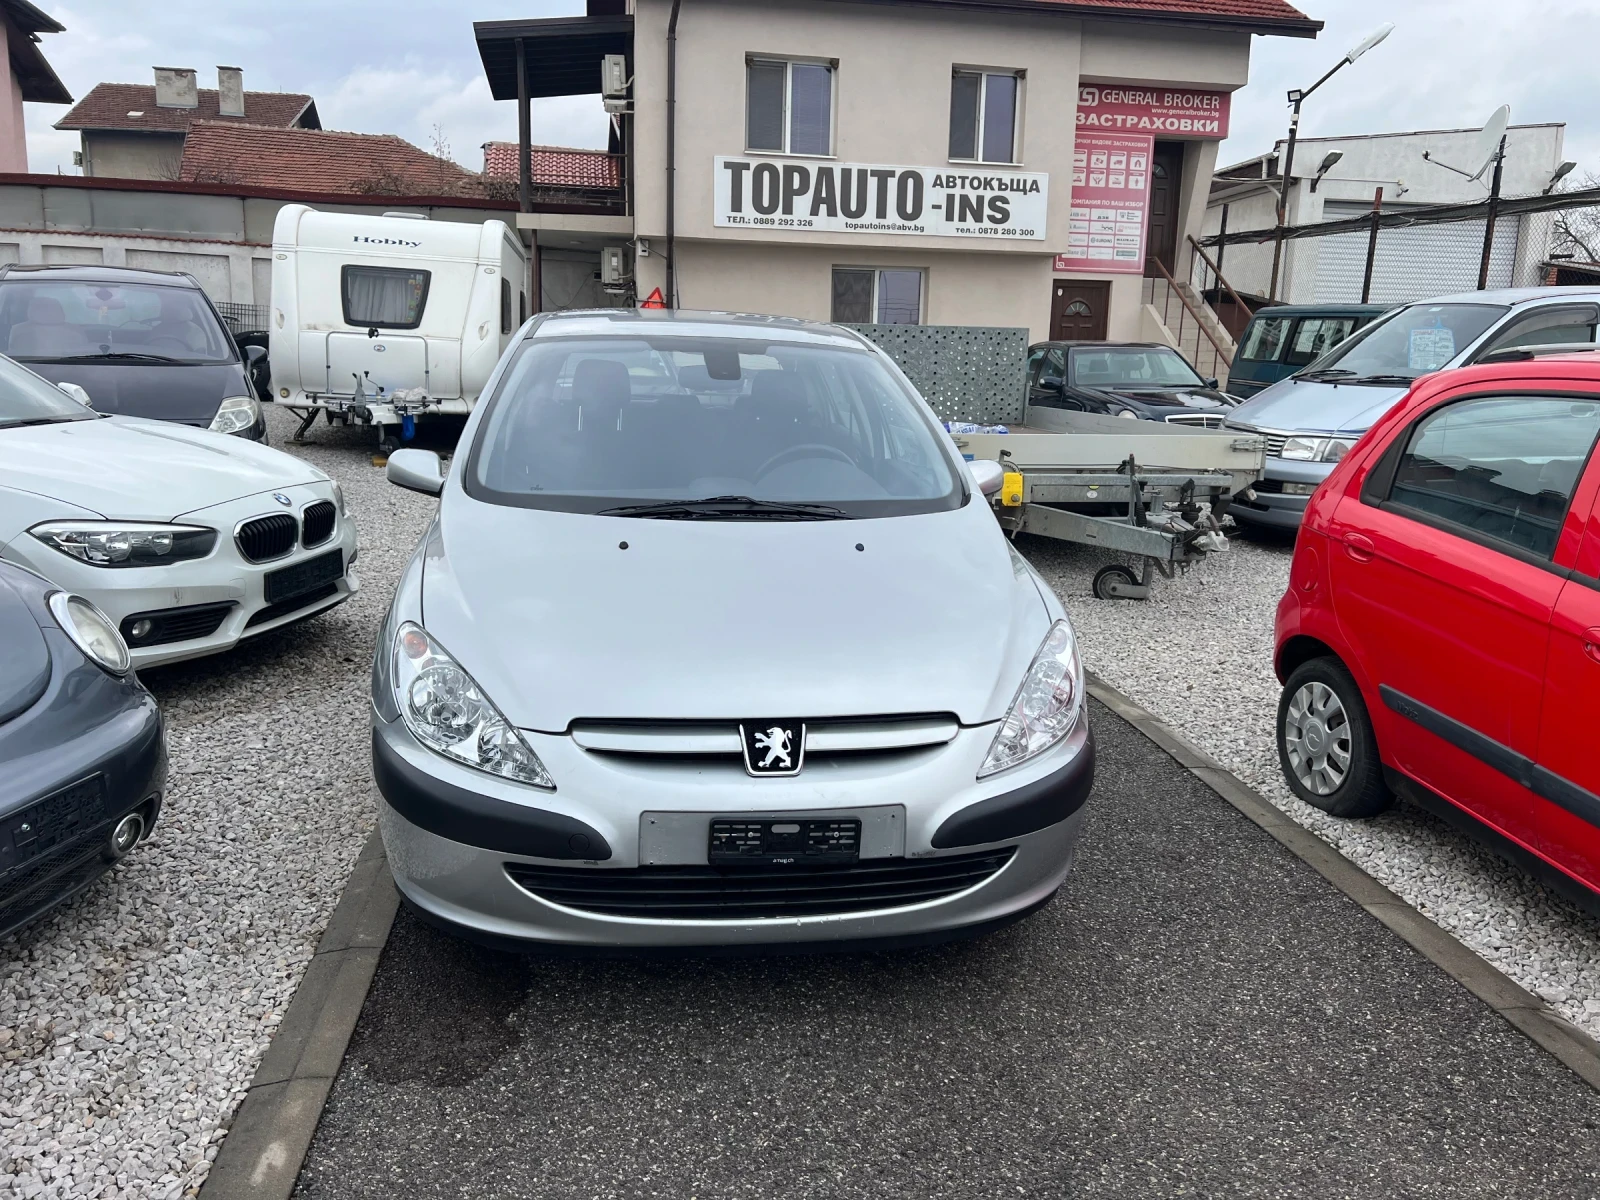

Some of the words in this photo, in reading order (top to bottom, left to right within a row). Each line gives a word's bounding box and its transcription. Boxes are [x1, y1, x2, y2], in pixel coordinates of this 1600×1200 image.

[1101, 89, 1160, 106] GENERAL
[1164, 93, 1220, 109] BROKER
[1151, 107, 1220, 118] www.generalbroker.bg
[1076, 112, 1219, 133] ЗАСТРАХОВКИ
[1113, 140, 1148, 148] ЗАСТРАХОВКИ
[931, 174, 1041, 195] АВТОКЪЩА
[723, 161, 924, 222] TOPAUTO
[931, 193, 1011, 225] -INS
[726, 215, 751, 225] ТЕЛ.:
[753, 217, 775, 226] 0889
[778, 218, 795, 226] 292
[796, 219, 814, 227] 326
[844, 221, 925, 233] topautoins@abv.bg
[977, 227, 999, 235] 0878
[1018, 228, 1035, 236] 300
[352, 235, 423, 248] Hobby
